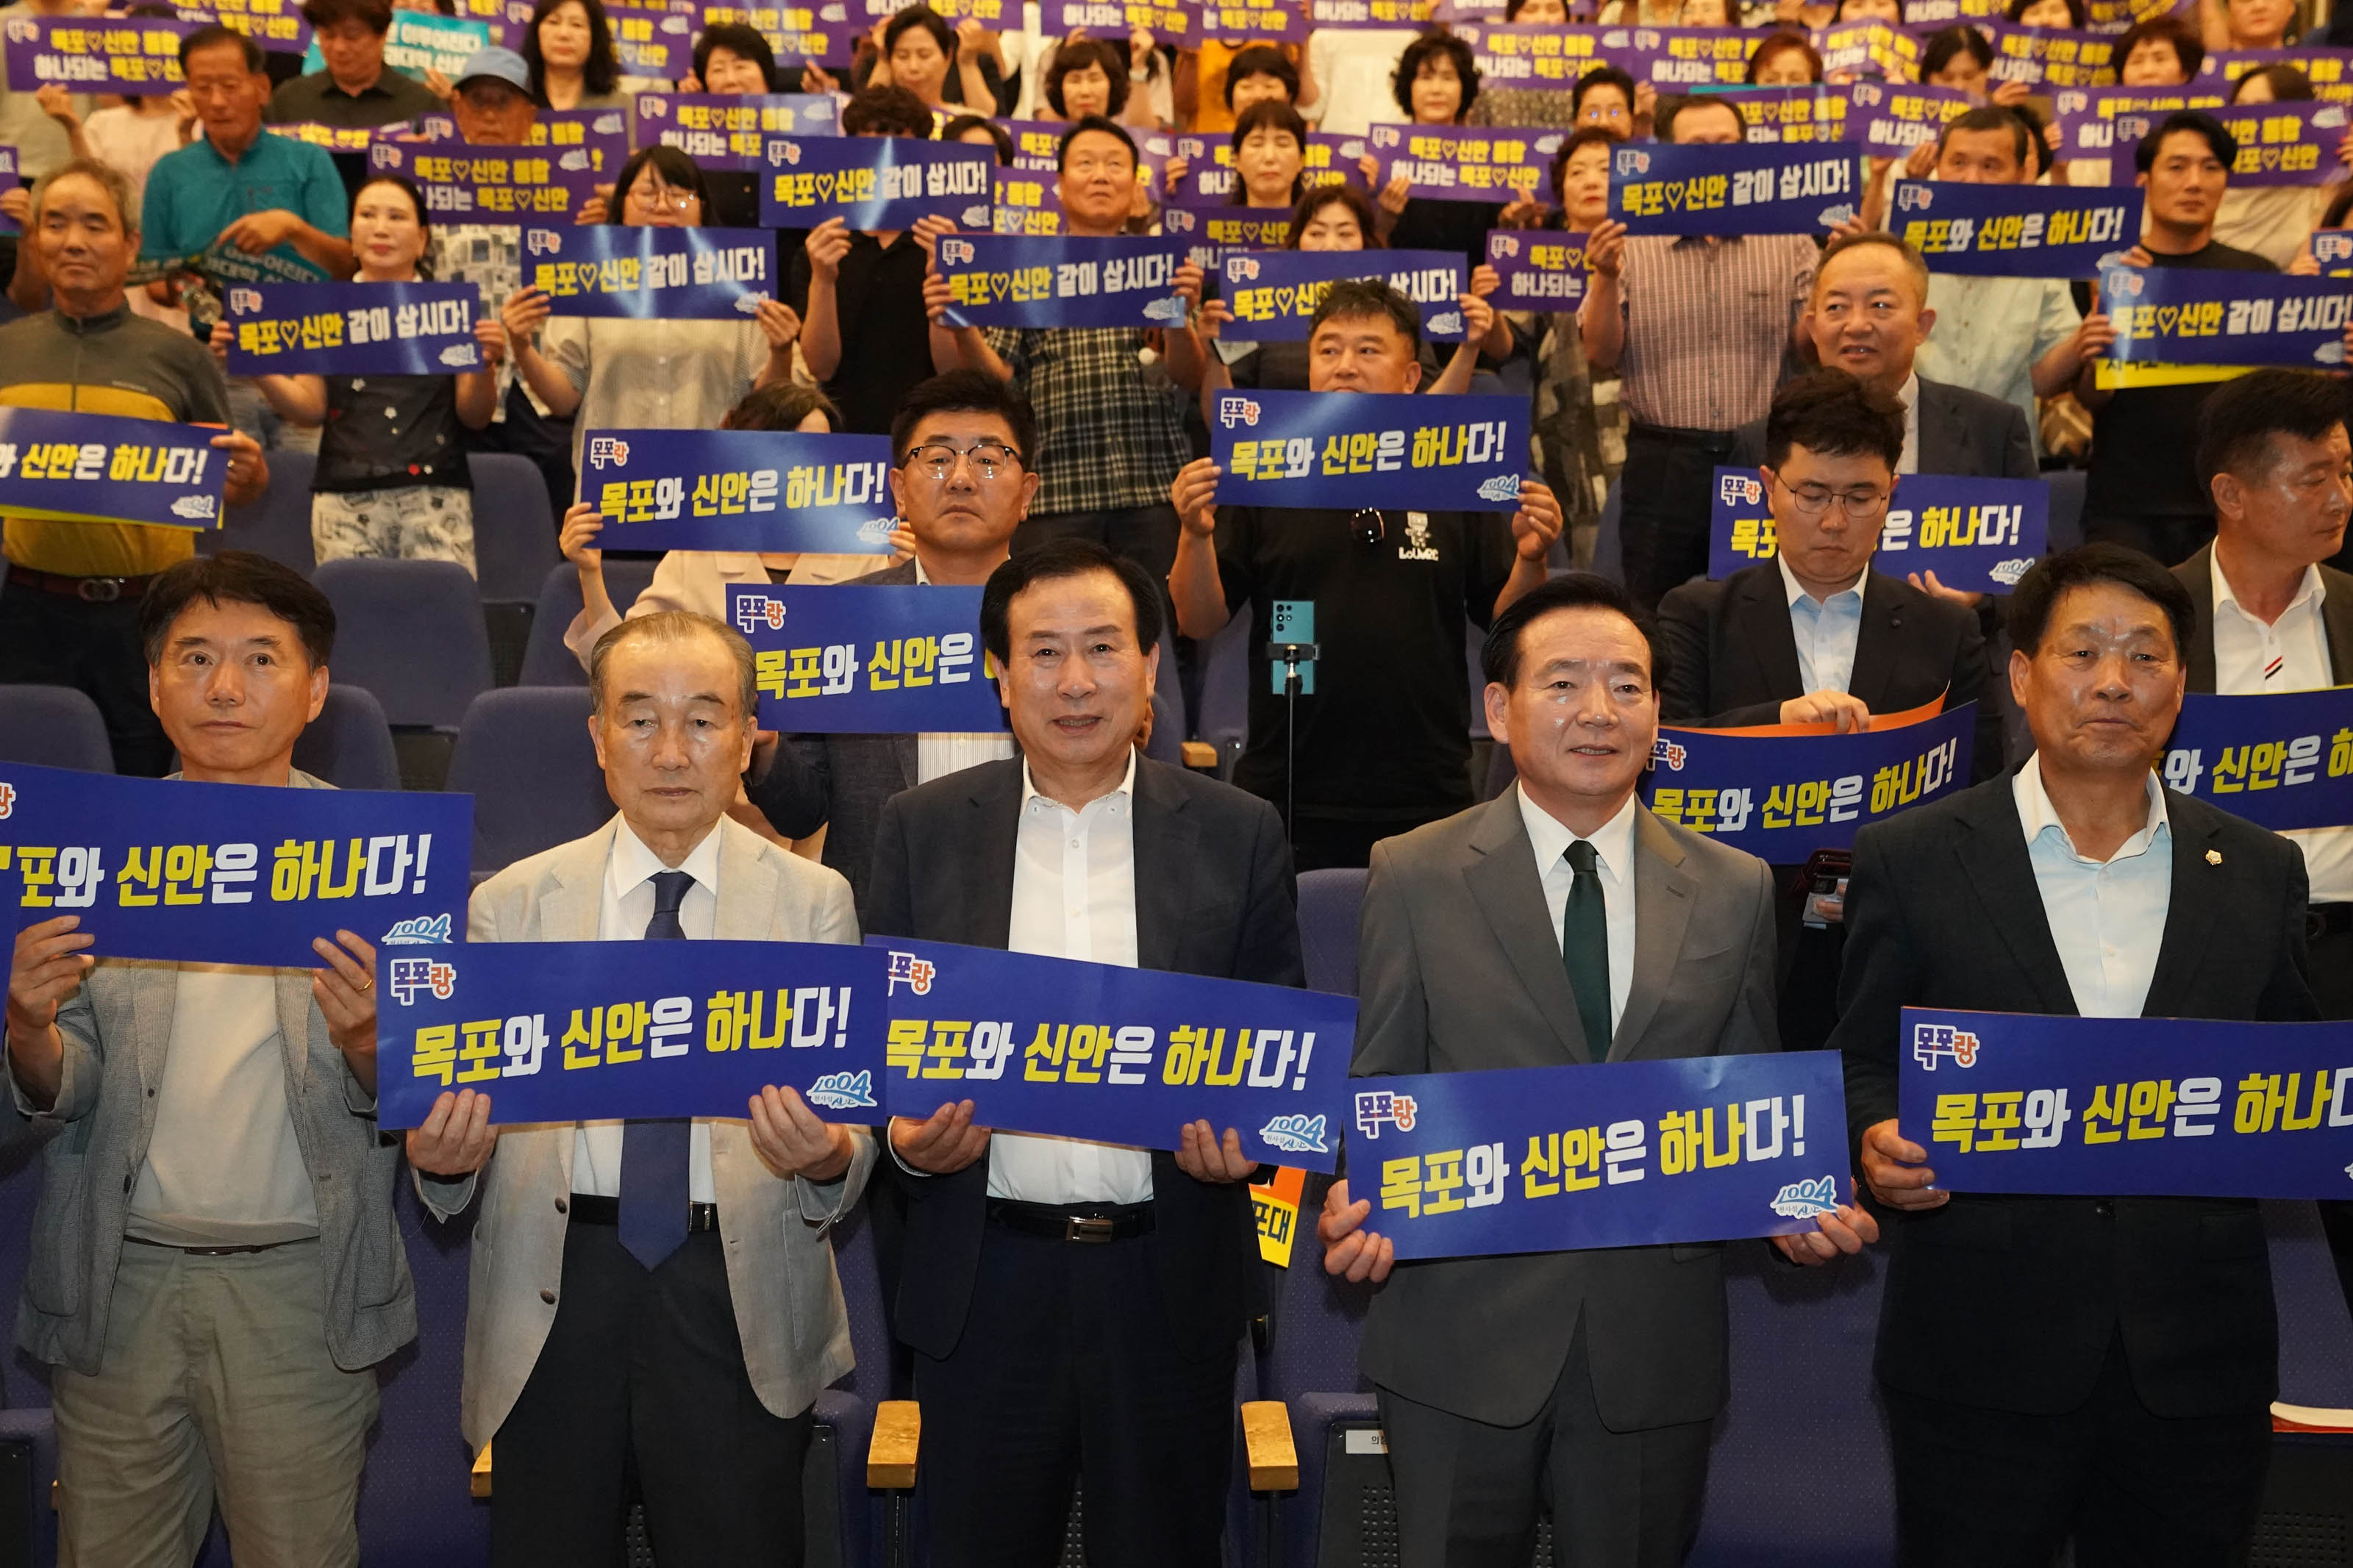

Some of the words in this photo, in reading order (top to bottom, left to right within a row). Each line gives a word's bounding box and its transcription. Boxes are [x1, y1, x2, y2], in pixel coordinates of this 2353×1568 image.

[882, 164, 922, 199] 같이
[926, 162, 987, 198] 삽시다!
[1732, 168, 1774, 206] 같이
[1779, 159, 1850, 200] 삽시다!
[1978, 213, 2045, 251] 신안은
[2046, 207, 2125, 245] 하나다!
[646, 253, 688, 290] 같이
[693, 247, 765, 284] 삽시다!
[1057, 262, 1099, 298] 같이
[1103, 254, 1174, 293] 삽시다!
[348, 307, 391, 344] 같이
[395, 299, 470, 338] 삽시다!
[2227, 299, 2274, 335] 같이
[21, 443, 107, 480] 신안은
[109, 444, 208, 484] 하나다!
[1229, 438, 1315, 481] 목포와
[1321, 430, 1405, 476] 신안은
[1411, 421, 1507, 468] 하나다!
[600, 477, 685, 523] 목포와
[692, 470, 778, 516] 신안은
[786, 462, 885, 509] 하나다!
[1919, 504, 2022, 548] 하나다!
[756, 644, 859, 699] 목포와
[868, 632, 973, 691] 신안은
[1652, 789, 1754, 833] 목포와
[1763, 776, 1863, 829] 신안은
[1871, 737, 1957, 814] 하나다!
[2212, 735, 2321, 794] 신안은
[116, 843, 258, 907] 신안은
[271, 834, 432, 902] 하나다!
[388, 916, 449, 944] 1004
[412, 1014, 549, 1086] 목포와
[561, 997, 693, 1070] 신안은
[706, 987, 851, 1053] 하나다!
[887, 1020, 1014, 1079] 목포와
[1024, 1024, 1155, 1085] 신안은
[1163, 1025, 1315, 1091] 하나다!
[812, 1073, 870, 1103] 1004
[1265, 1117, 1324, 1148] 1004
[1932, 1089, 2071, 1153] 목포와
[2082, 1077, 2221, 1145] 신안은
[1380, 1143, 1509, 1218] 목포와
[1521, 1120, 1646, 1200] 신안은
[1658, 1095, 1804, 1175] 하나다!
[1777, 1178, 1834, 1209] 1004
